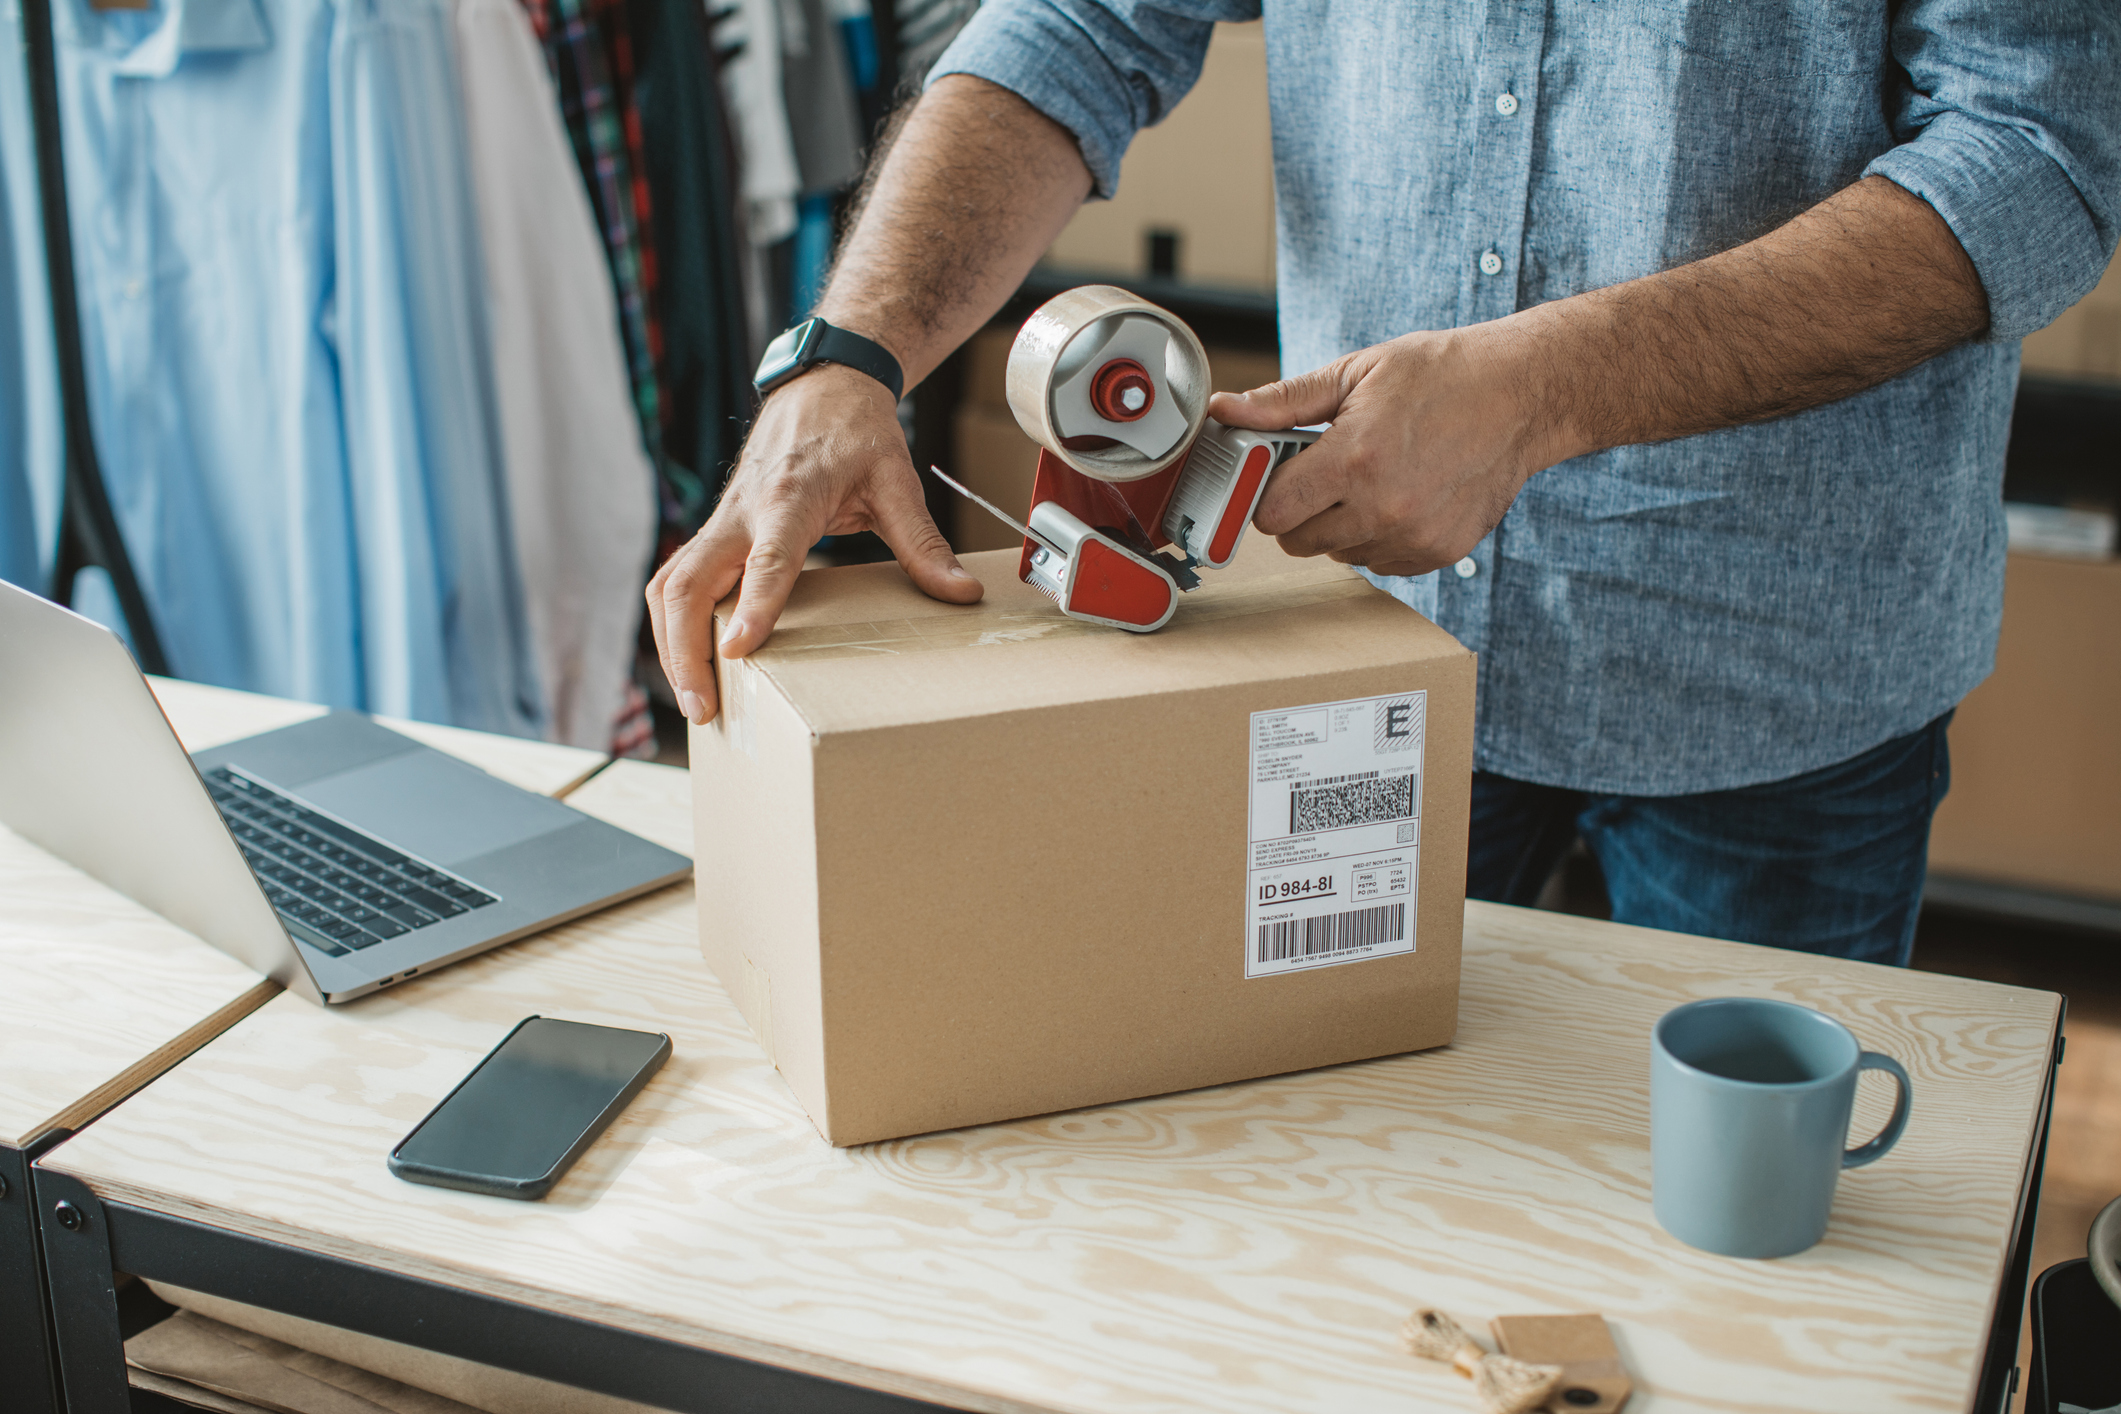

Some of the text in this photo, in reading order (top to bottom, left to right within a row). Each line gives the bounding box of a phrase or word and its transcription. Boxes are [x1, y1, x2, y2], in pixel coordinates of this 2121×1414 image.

[1386, 703, 1410, 738] E
[1271, 733, 1304, 742] EVERGREEN
[1281, 754, 1303, 762] SNYDER
[1257, 762, 1291, 771] NOCOMPANY
[1271, 845, 1296, 853] EXPRESS
[1256, 859, 1285, 868] TRACKING#
[1260, 884, 1276, 900] ID
[1258, 912, 1288, 922] TRACKING
